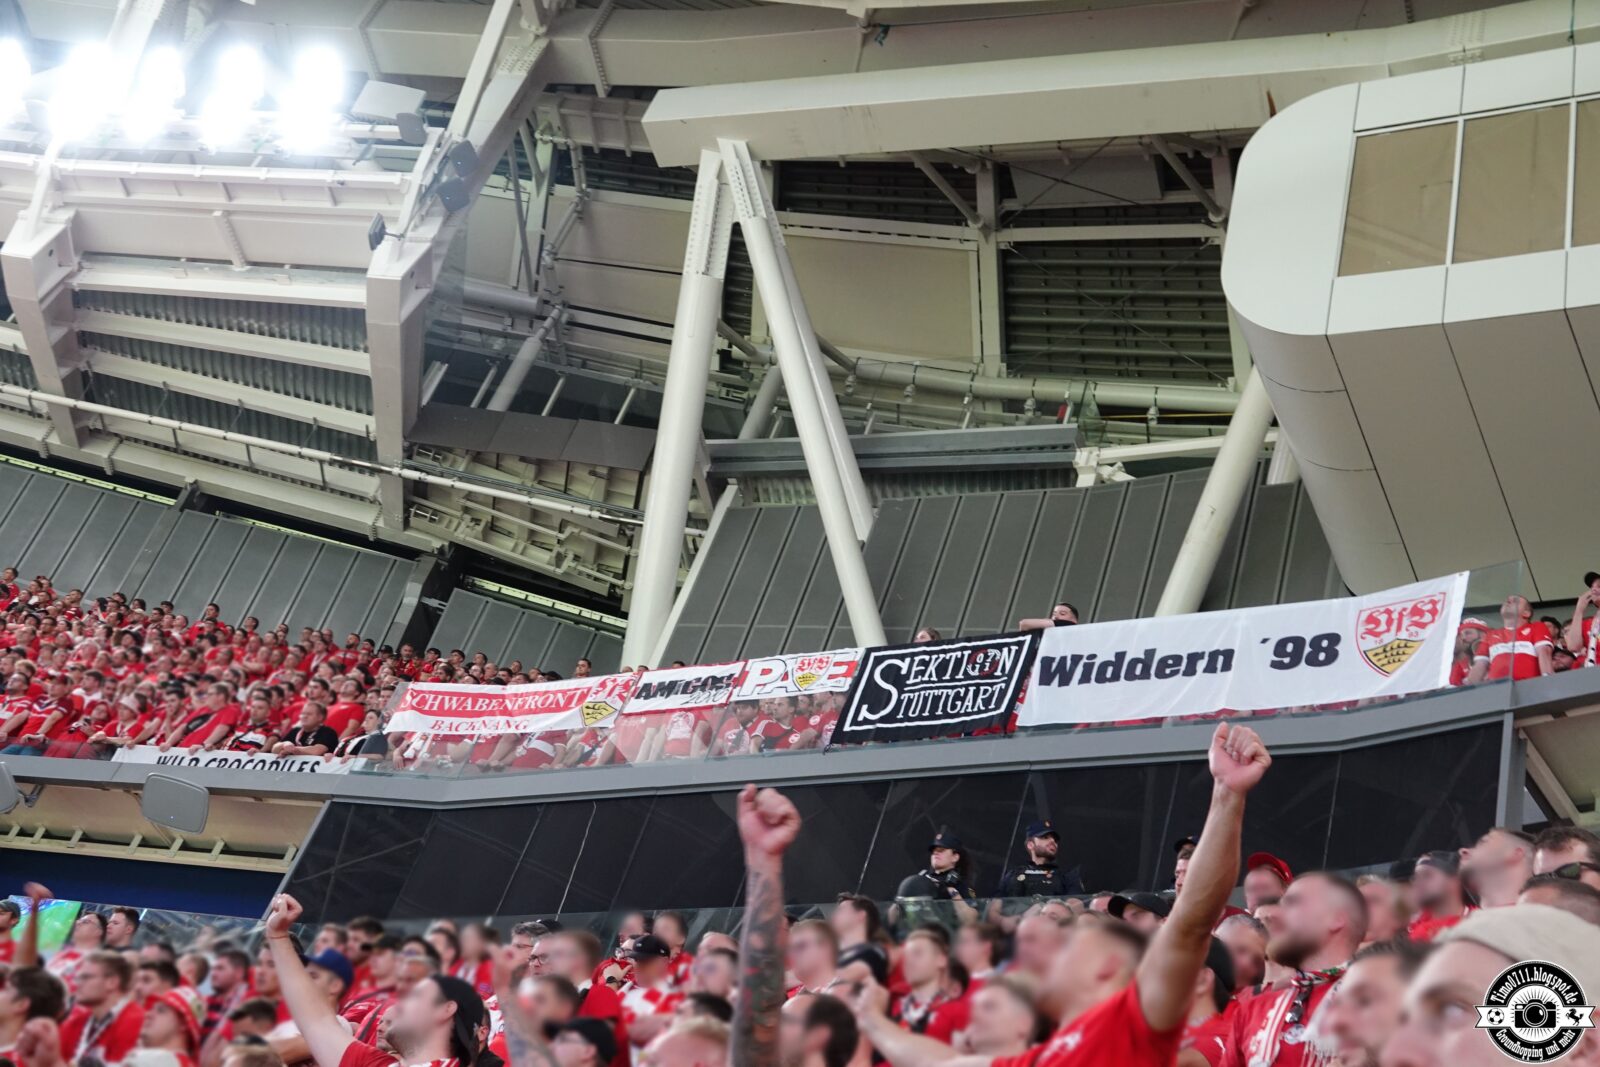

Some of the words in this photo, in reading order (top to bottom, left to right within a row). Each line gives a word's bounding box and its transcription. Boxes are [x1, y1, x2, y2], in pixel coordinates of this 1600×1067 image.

[1038, 647, 1235, 687] Widdern
[402, 688, 588, 712] SCHWABENFRONT
[431, 719, 528, 732] BACKNANG
